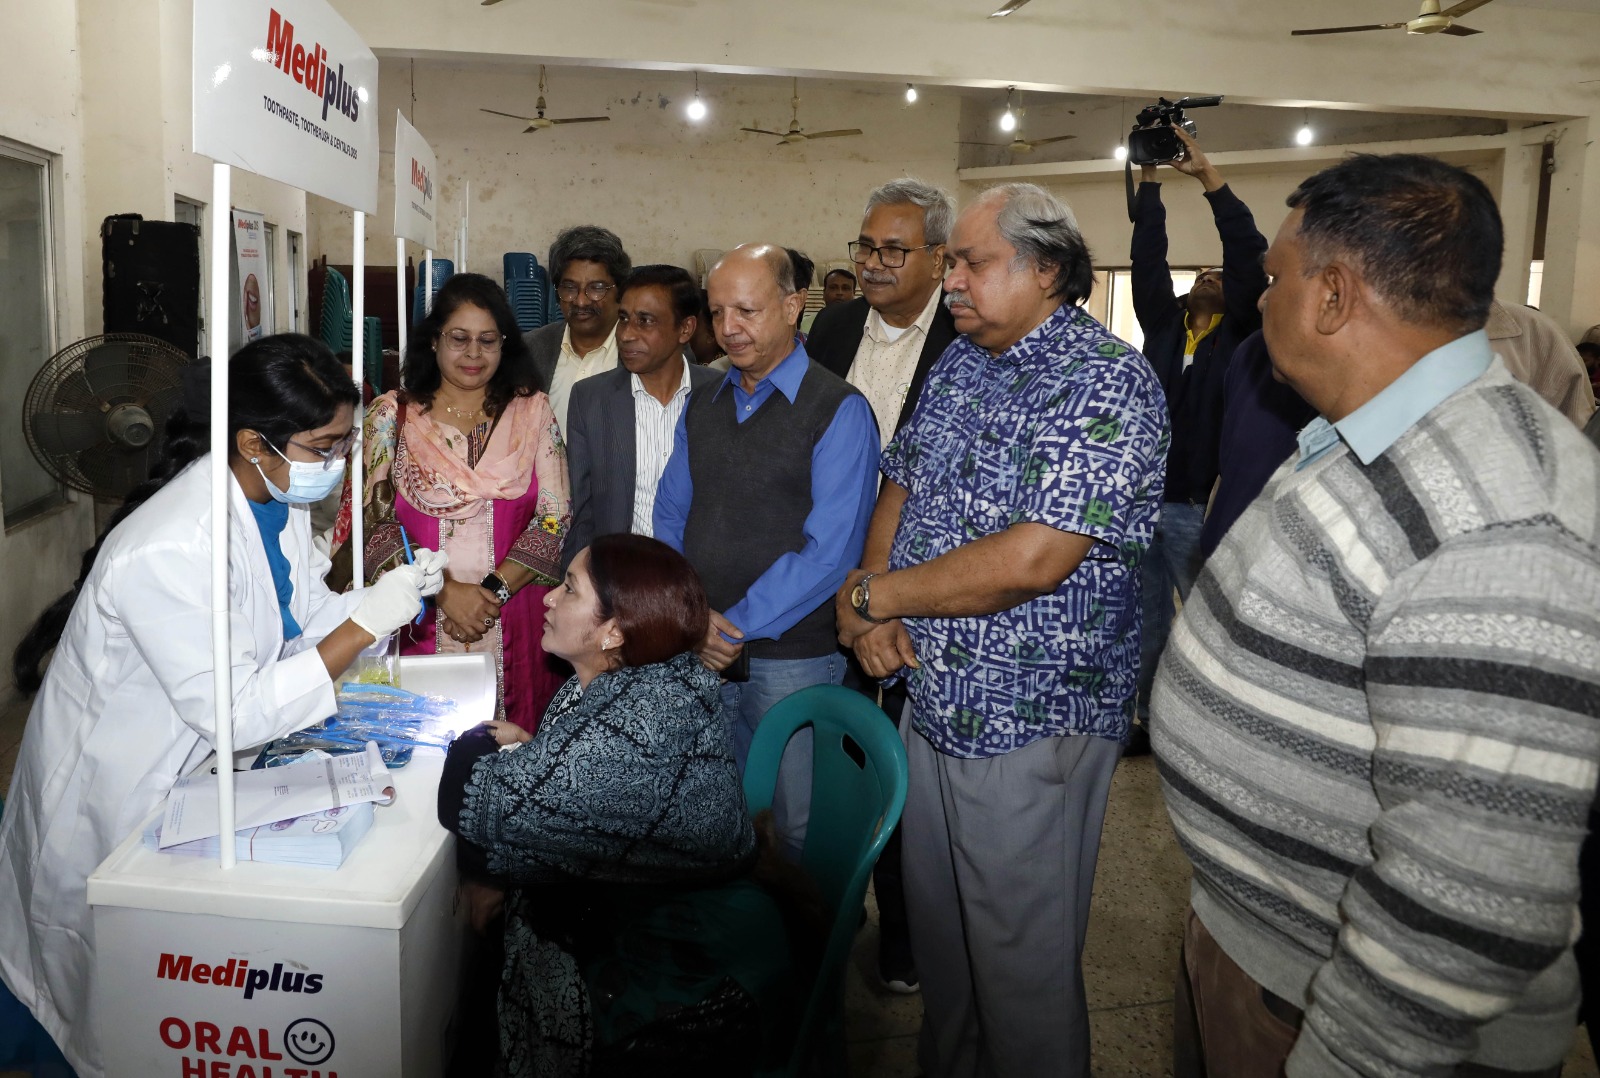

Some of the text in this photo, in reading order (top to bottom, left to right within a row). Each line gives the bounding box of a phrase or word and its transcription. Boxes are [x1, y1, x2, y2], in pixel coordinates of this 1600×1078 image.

[266, 7, 359, 122] Mediplus
[263, 95, 300, 130] TOOTHPASTE,
[411, 157, 433, 205] Mediplus
[157, 953, 324, 1000] Mediplus
[159, 1016, 283, 1061] ORAL
[182, 1056, 338, 1078] HEA
